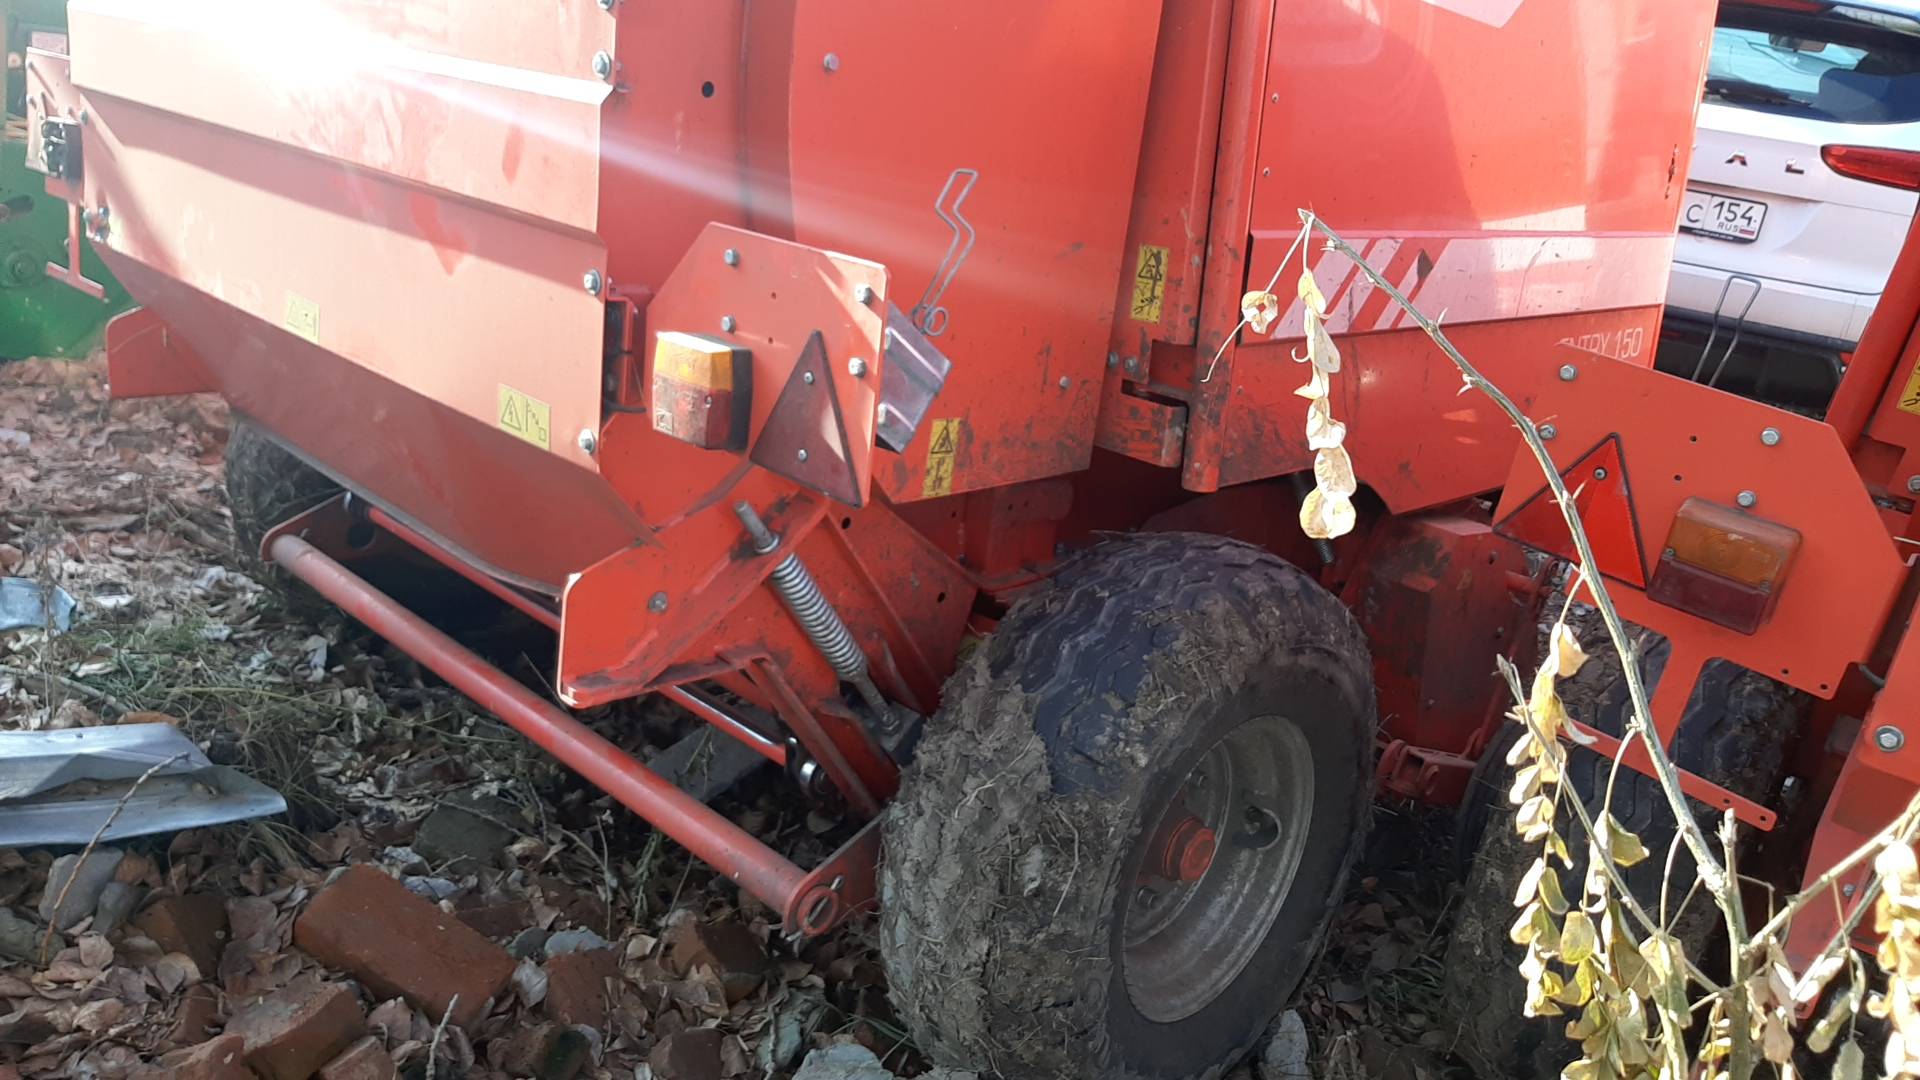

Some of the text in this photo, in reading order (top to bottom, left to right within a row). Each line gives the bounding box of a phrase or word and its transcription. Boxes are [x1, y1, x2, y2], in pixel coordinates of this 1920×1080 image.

[1713, 201, 1754, 227] 154
[1717, 221, 1738, 232] RUS
[1560, 328, 1643, 358] TRY 150
